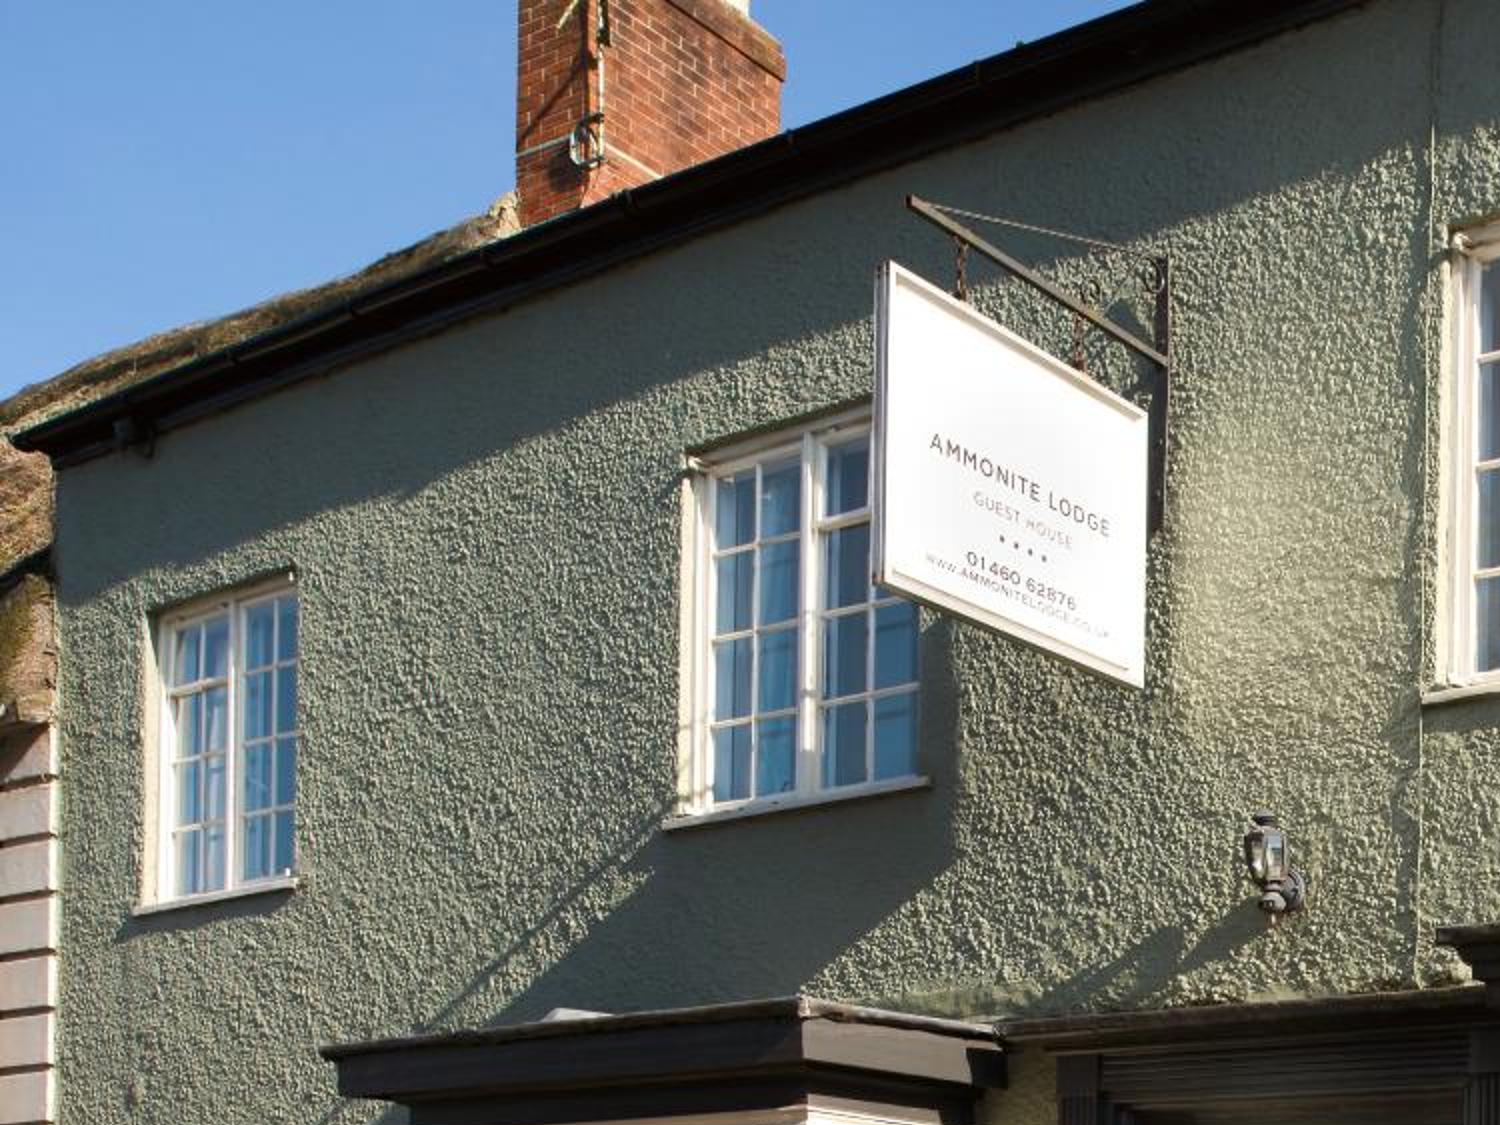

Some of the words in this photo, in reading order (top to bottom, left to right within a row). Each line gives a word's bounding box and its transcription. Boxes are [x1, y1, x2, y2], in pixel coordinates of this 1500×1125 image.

[929, 433, 1041, 503] AMMONITE
[1048, 491, 1110, 538] LODGE
[973, 490, 1020, 524] GUEST
[1025, 516, 1073, 550] HOUSE
[966, 551, 1021, 585] 01460
